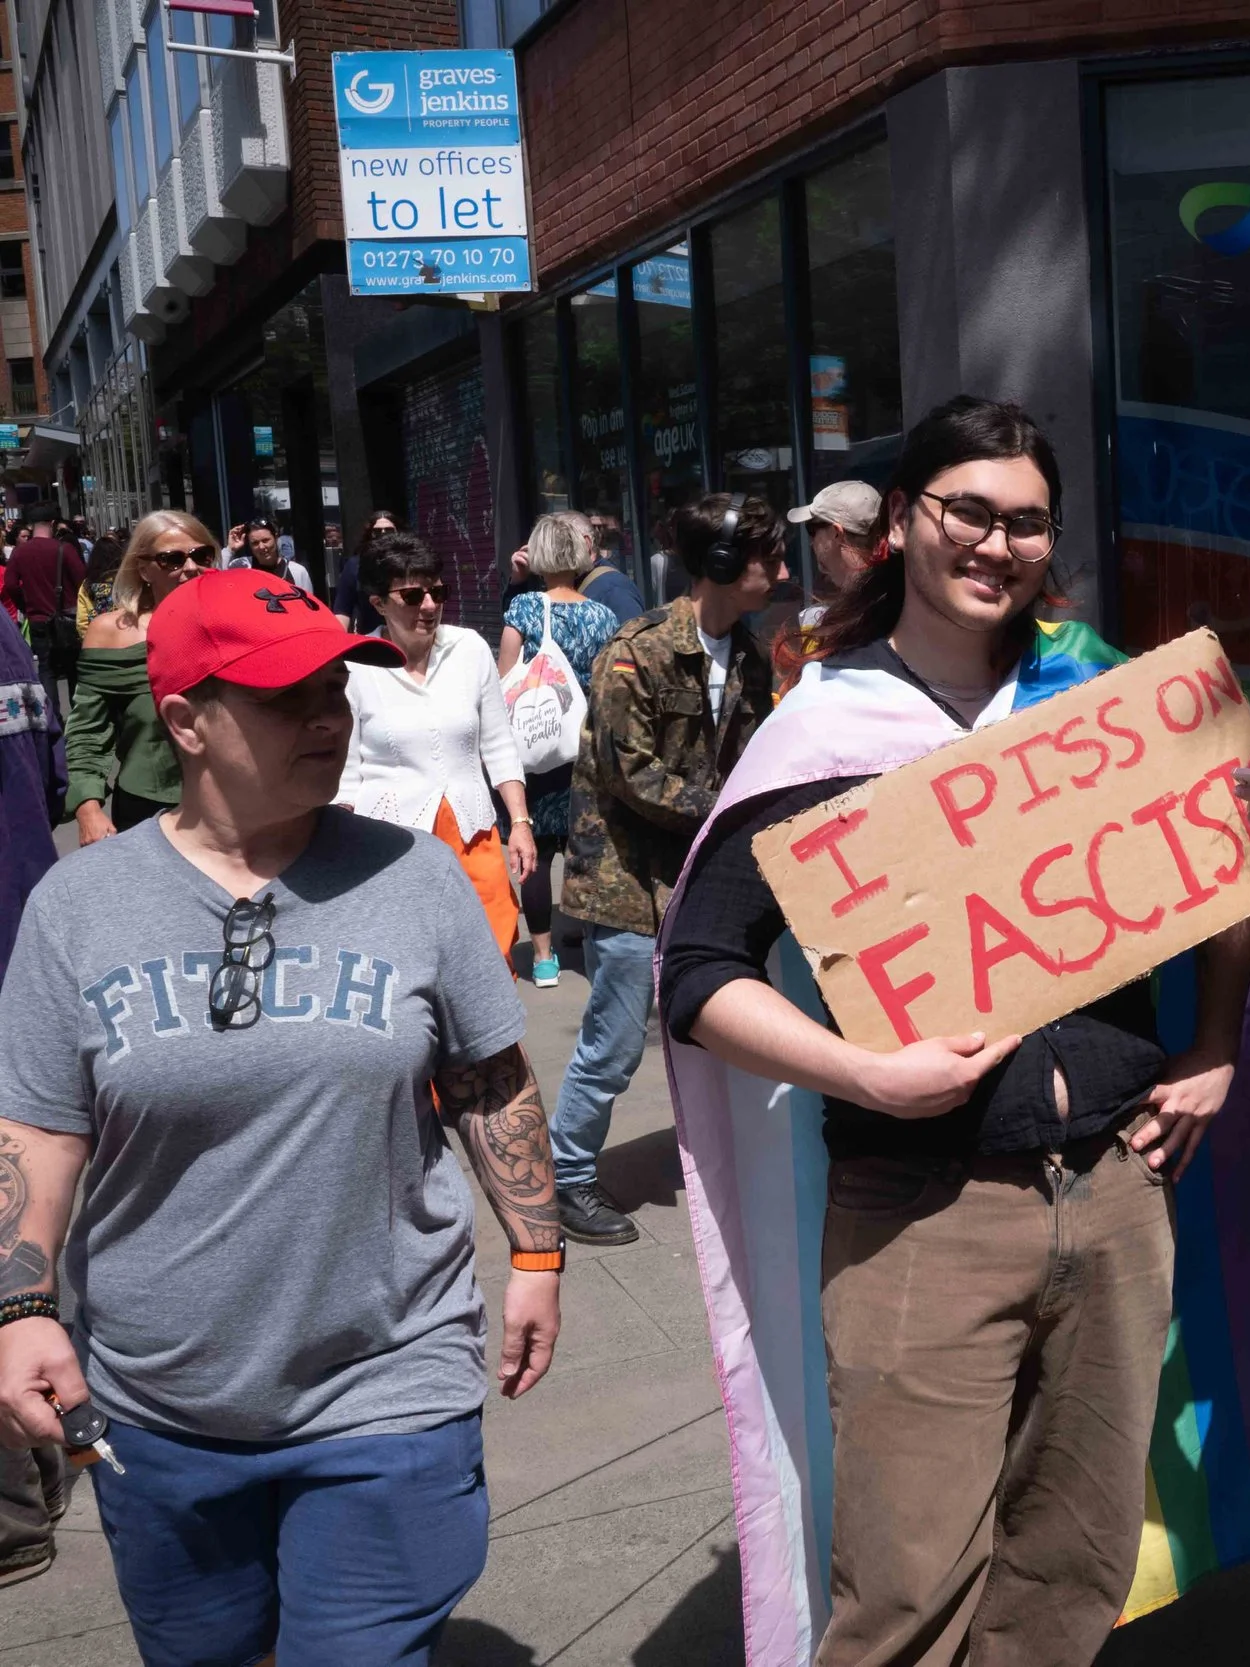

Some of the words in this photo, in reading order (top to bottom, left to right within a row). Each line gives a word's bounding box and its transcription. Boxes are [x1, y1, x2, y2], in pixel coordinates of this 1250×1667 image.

[419, 68, 496, 90] graves
[420, 91, 509, 116] jenkins
[423, 119, 471, 128] PROPERTY
[475, 118, 510, 127] PEOPLE
[352, 157, 408, 177] new
[419, 151, 512, 176] offices
[367, 191, 419, 231] to
[439, 187, 503, 230] let
[363, 250, 424, 269] 01273
[430, 249, 456, 268] 70
[462, 249, 483, 265] 10
[489, 248, 515, 267] 70
[365, 272, 517, 289] www.grajenkins.com
[523, 716, 562, 749] reality
[790, 808, 889, 919] I
[931, 696, 1146, 849] PISS
[1155, 655, 1244, 734] ON
